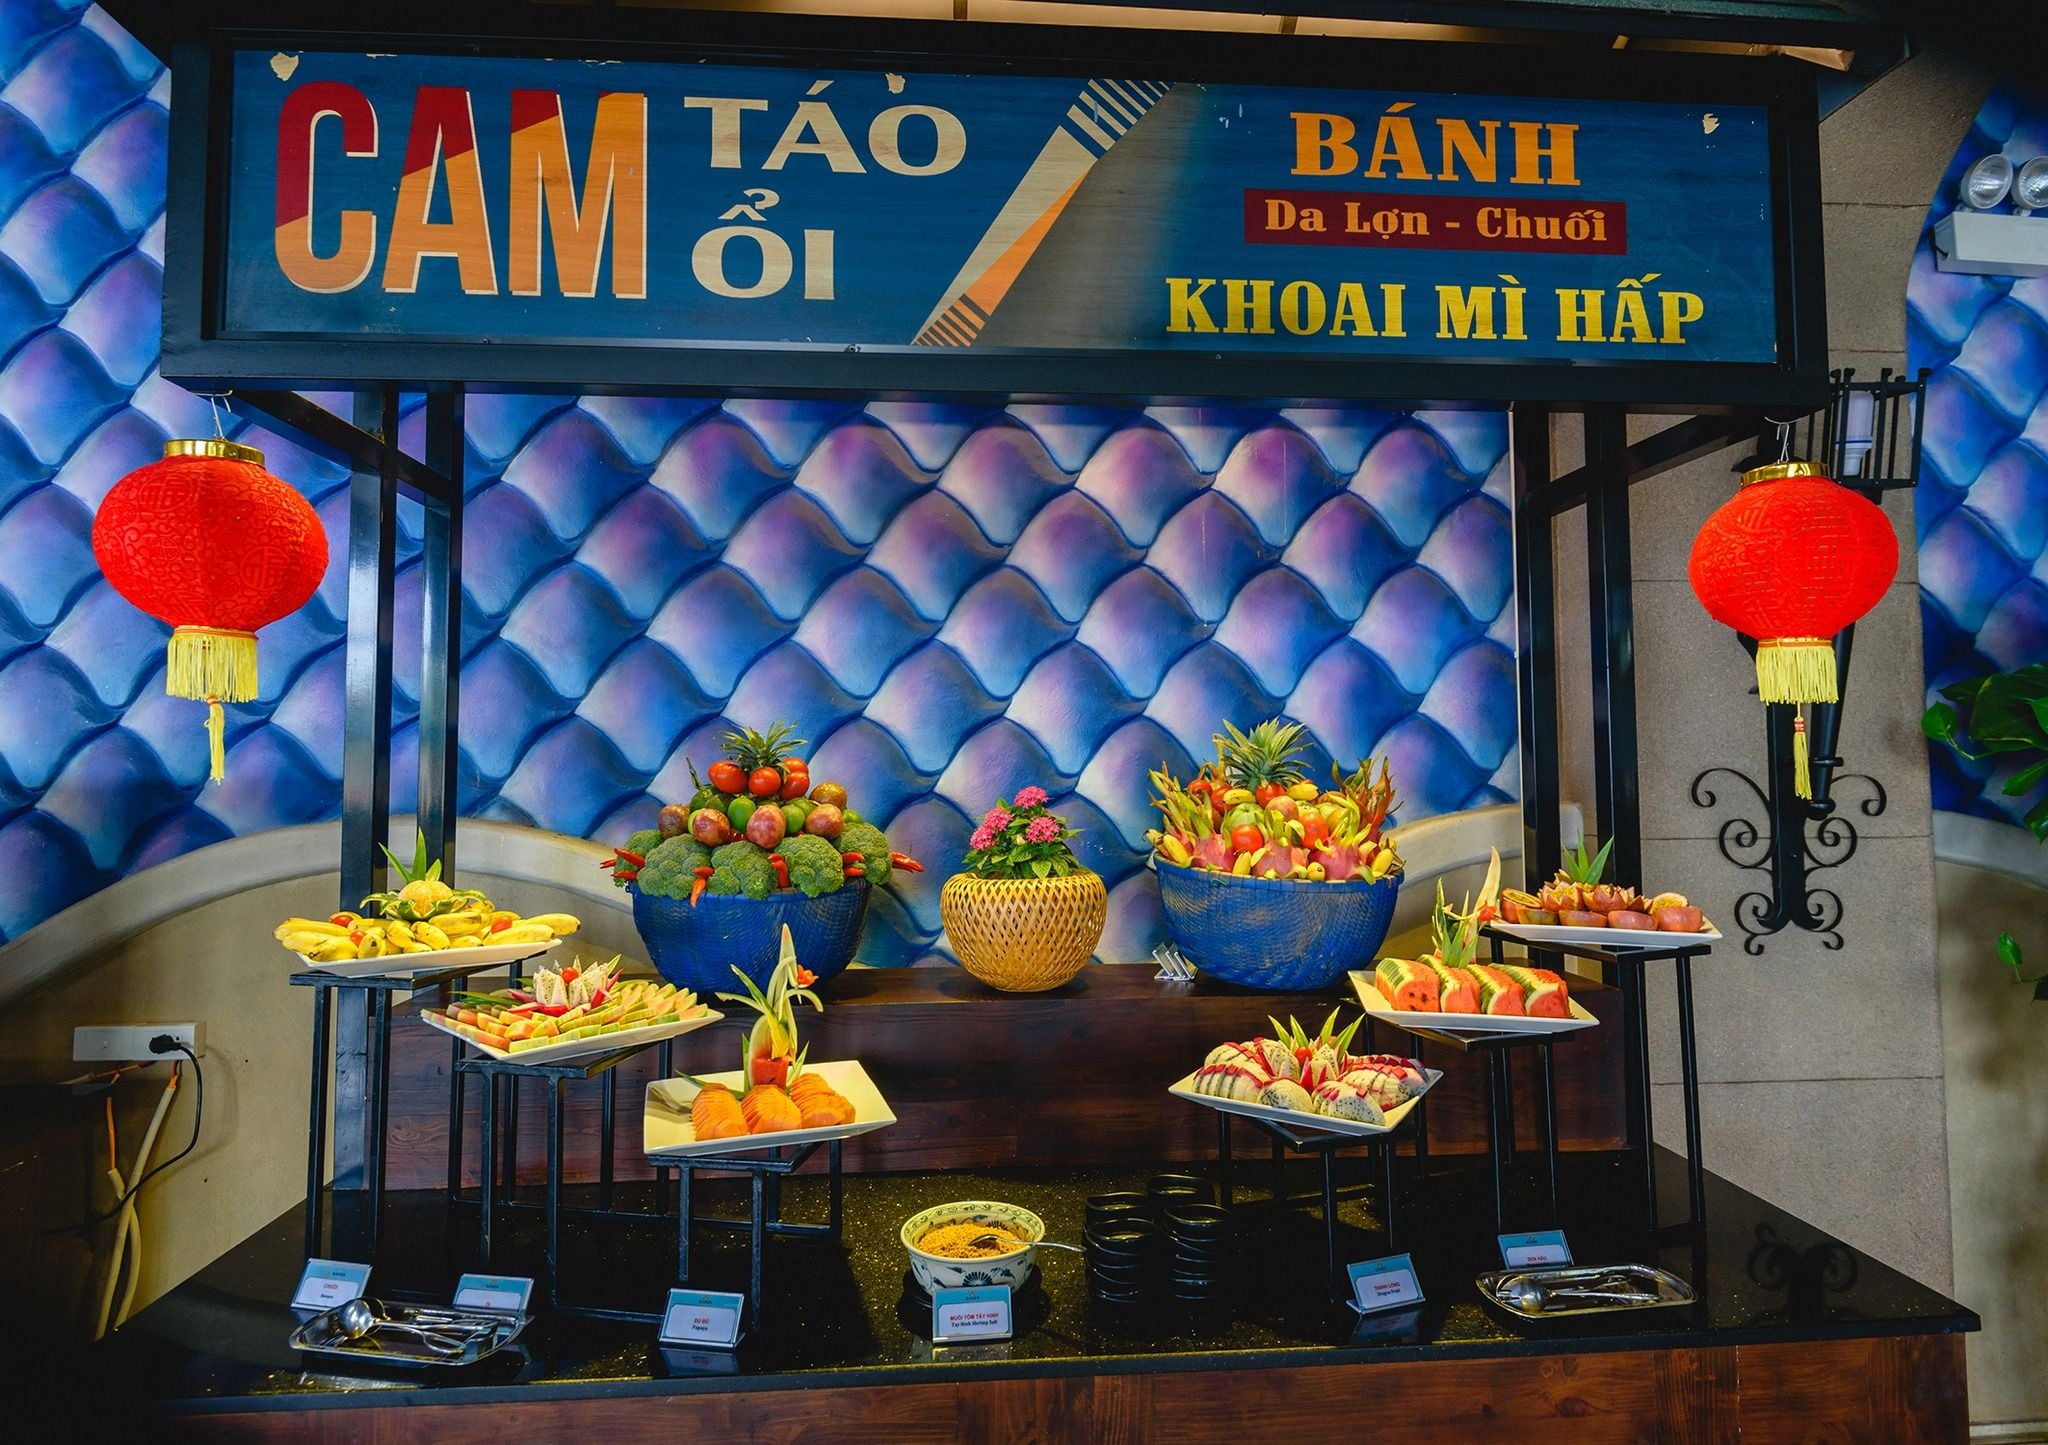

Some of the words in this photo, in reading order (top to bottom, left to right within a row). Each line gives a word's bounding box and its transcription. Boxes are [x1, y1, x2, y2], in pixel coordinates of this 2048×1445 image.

[684, 79, 967, 176] TÁO
[1289, 102, 1581, 187] BÁNH
[274, 80, 648, 300] CAM
[1264, 199, 1328, 233] Da
[1344, 201, 1431, 240] Lợn
[1475, 206, 1608, 242] Chuối
[691, 187, 836, 301] ỔI
[1165, 276, 1407, 338] KHOAI
[1434, 273, 1529, 341] MÌ
[1554, 272, 1705, 345] HẤP
